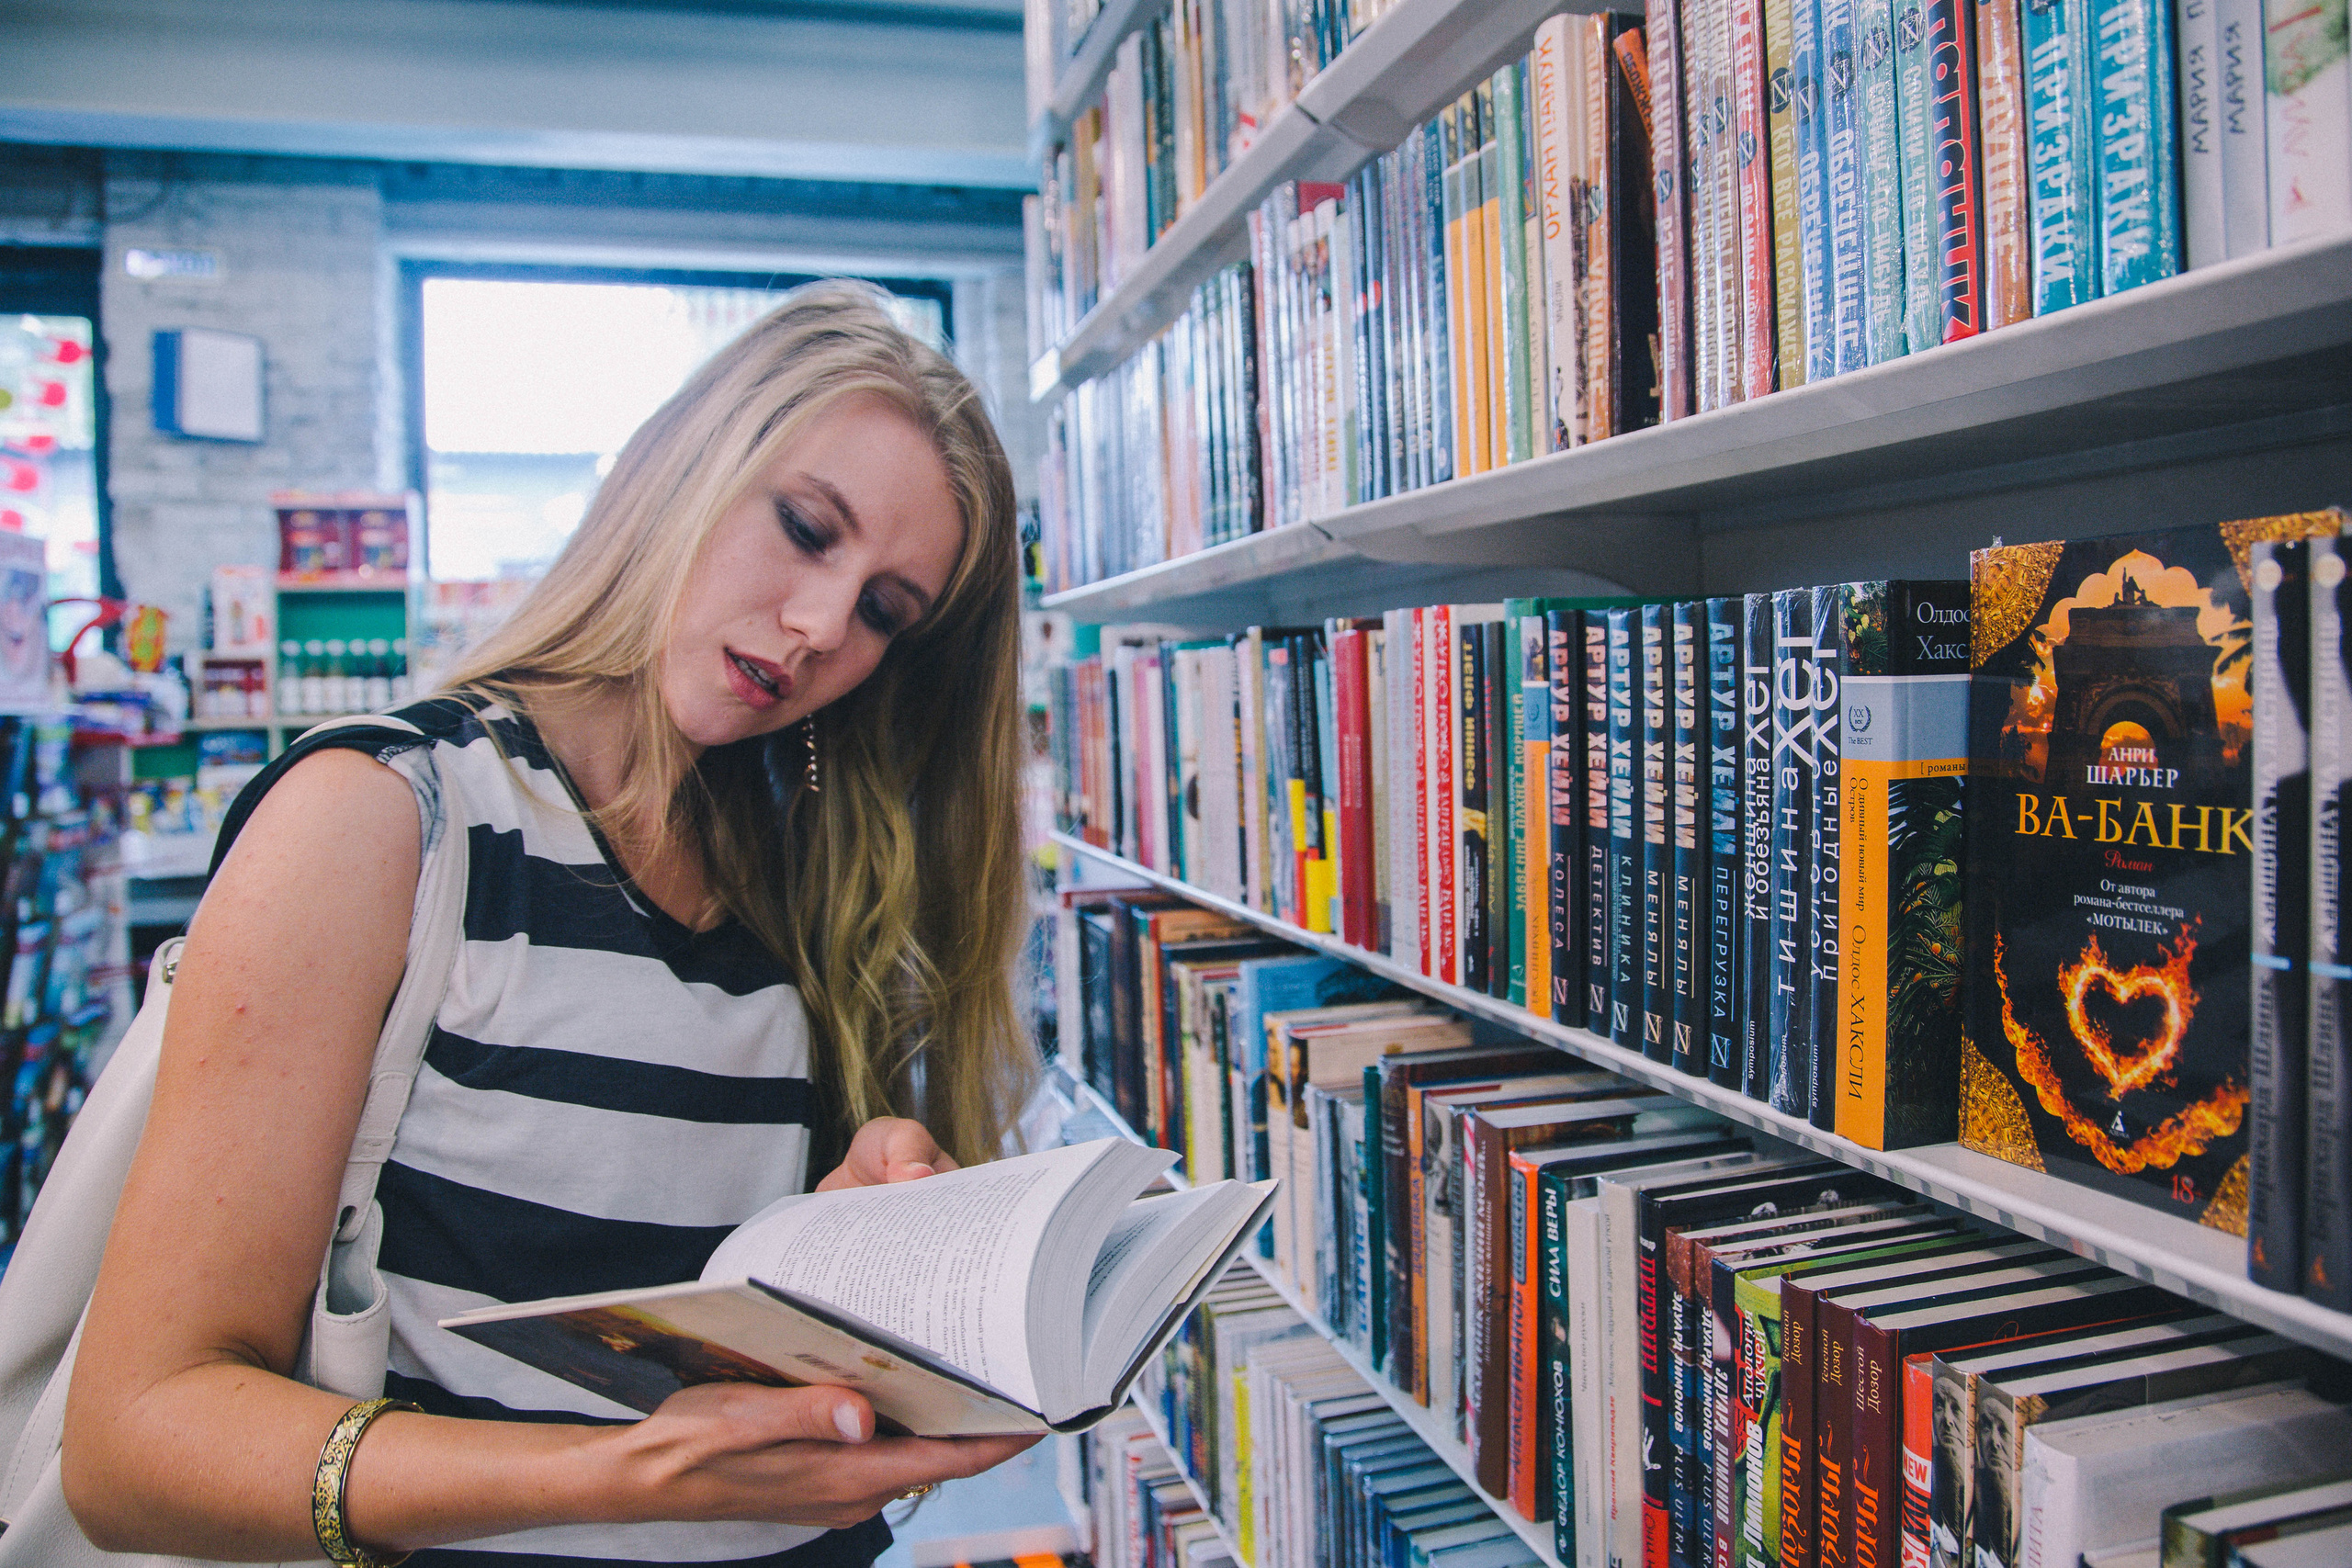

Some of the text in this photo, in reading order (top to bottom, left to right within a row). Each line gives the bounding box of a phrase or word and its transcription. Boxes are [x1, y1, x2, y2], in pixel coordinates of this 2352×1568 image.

[1648, 13, 1672, 157] ПАЛАНИК
[2188, 45, 2209, 153] МАРИЯ
[2225, 20, 2245, 135] МАРИЯ
[1538, 37, 1560, 241] ОРХАН ПАМУК
[1979, 46, 2019, 258] УДУШЬЕ
[2030, 33, 2075, 286] ПРИЗРАКИ
[1772, 125, 1800, 371] КТО ВСЕ РАССКАЖЕТ
[1847, 736, 1873, 746] The BEST
[1928, 761, 1966, 773] романы
[2086, 764, 2179, 789] ШАРЬЕР
[2108, 746, 2156, 764] АНРИ
[1549, 628, 1573, 949] АРТУР ХЕЙЛИ КОЛЕСА
[1585, 626, 1610, 966] АРТУР ХЕЙЛИ ДЕТЕКТИВ
[1611, 628, 1634, 984] АРТУР ХЕЙЛИ КЛИНИКА
[1643, 625, 1668, 987] АРТУР ХЕЙЛИ МЕНЯЛЫ
[1673, 623, 1699, 995] АРТУР ХЕЙЛИ МЕНЯЛЫ
[1709, 621, 1740, 1019] АРТУР ХЕЙЛИ ПЕРЕГРУЗКА
[1849, 776, 1859, 823] Остров
[2015, 792, 2255, 855] ВА-БАНК
[1755, 757, 1770, 920] и обезьяна
[1823, 759, 1840, 982] пригодные
[1855, 777, 1869, 912] О дивный новый мир
[2104, 849, 2154, 874] Роман
[1778, 765, 1799, 998] тишина
[2073, 892, 2185, 919] романа-бестселлера
[2100, 878, 2156, 899] От автора
[2086, 912, 2169, 936] «МОТЫЛЕК»
[1848, 924, 1867, 1101] Олдос ХАКСЛИ
[1747, 1020, 1756, 1080] symposium
[1811, 1043, 1820, 1108] symposium
[959, 1296, 968, 1357] забарабанил
[977, 1296, 986, 1354] первый раз
[1544, 1188, 1568, 1527] ФЕДОР КОНЮХОВ СИЛА ВЕРЫ
[1701, 1306, 1713, 1367] ЭДУАРД
[1742, 1309, 1756, 1410] Апология
[1781, 1309, 1792, 1364] Теневой
[1790, 1320, 1804, 1366] Дозор
[1821, 1328, 1830, 1384] Теневой
[1753, 1328, 1770, 1400] чукчей
[1829, 1340, 1843, 1386] Дозор
[1855, 1346, 1865, 1413] Шестой
[1866, 1359, 1882, 1414] Дозор
[1671, 1291, 1685, 1554] ЭДУАРД ЛИМОНОВ PLUS ULTRA
[1702, 1370, 1713, 1451] ЛИМОНОВ
[1714, 1367, 1729, 1438] ЭДУАРД
[1702, 1462, 1713, 1511] PLUS
[1715, 1439, 1730, 1525] ЛИМОНОВ
[1742, 1420, 1764, 1551] Лимонов
[1903, 1457, 1928, 1486] NEW
[1717, 1537, 1727, 1550] В
